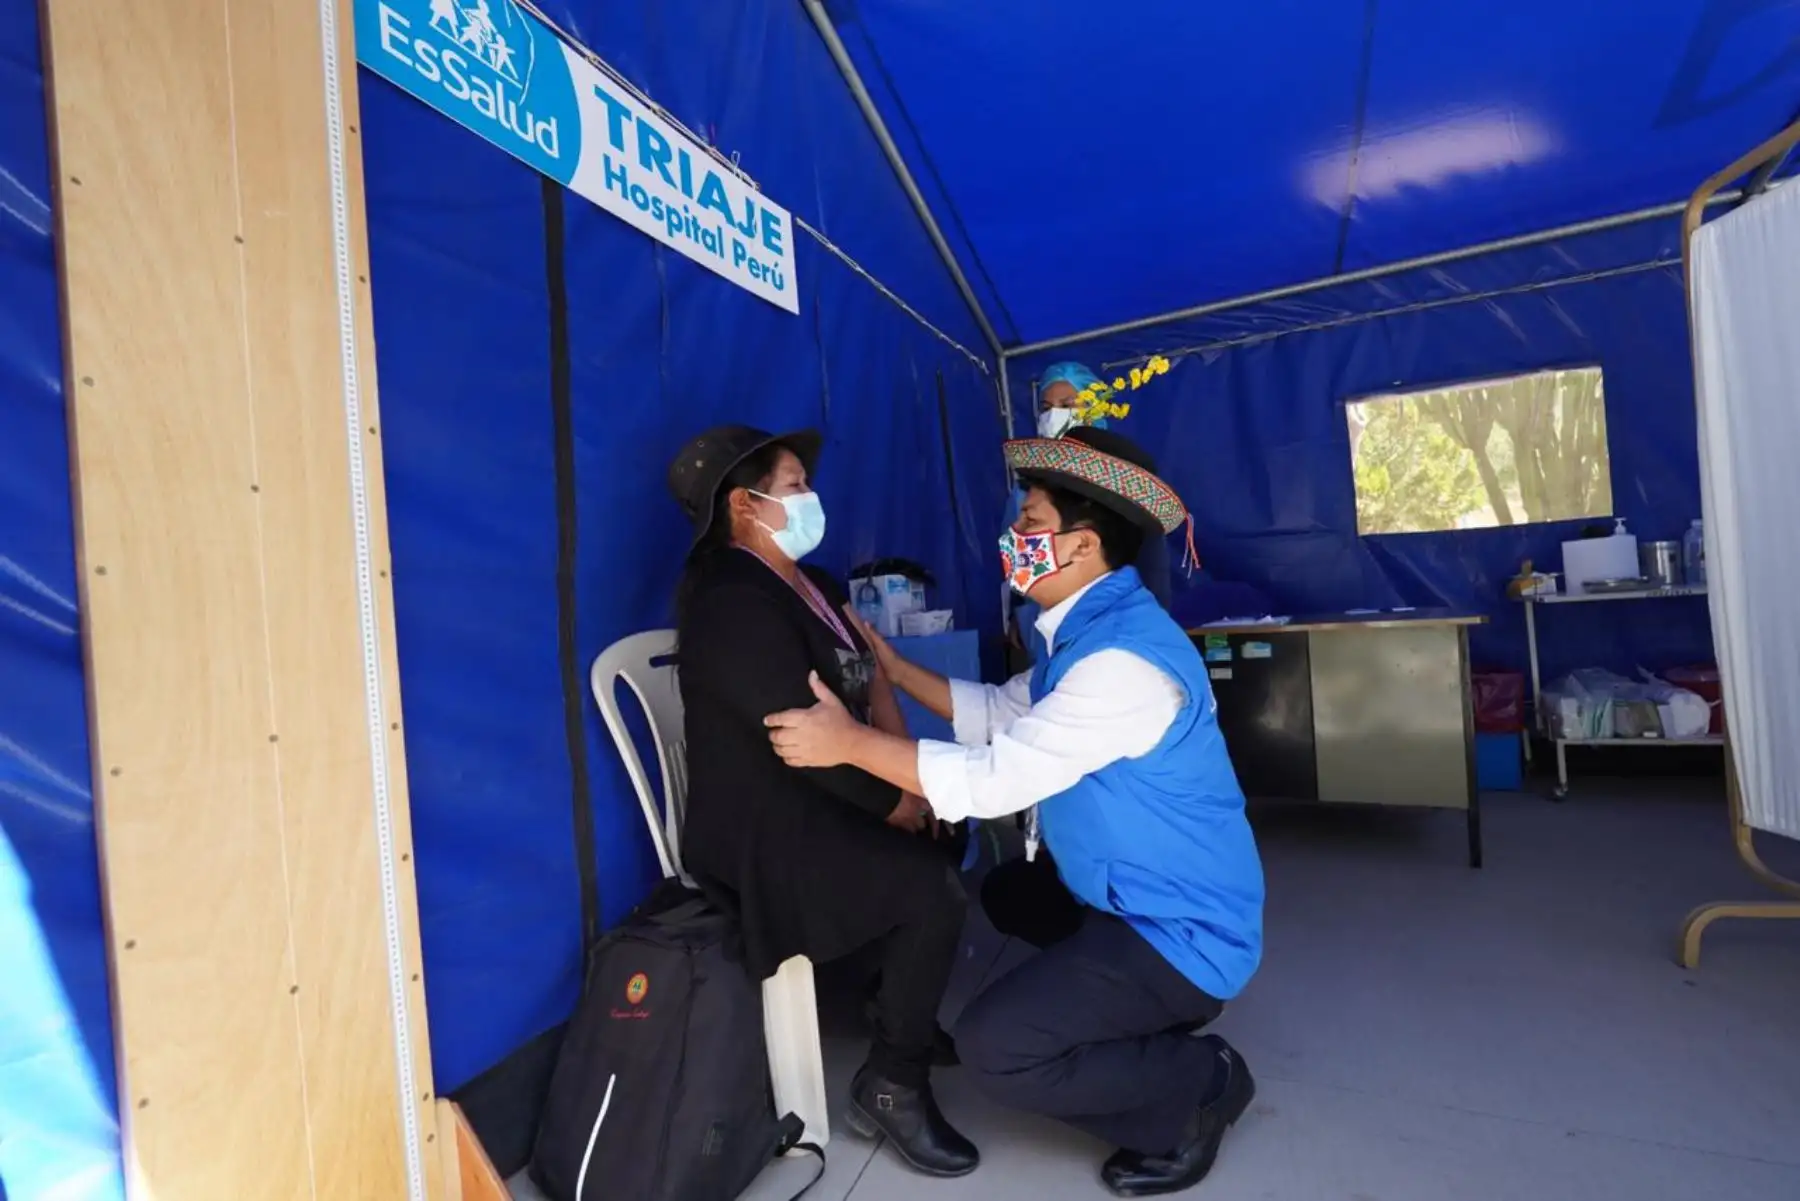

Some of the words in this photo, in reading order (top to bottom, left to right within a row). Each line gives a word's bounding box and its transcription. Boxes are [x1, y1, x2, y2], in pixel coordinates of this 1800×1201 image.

[378, 1, 560, 159] EsSalud
[593, 84, 784, 257] TRIAJE
[603, 152, 725, 259] Hospital
[732, 236, 785, 292] Perú
